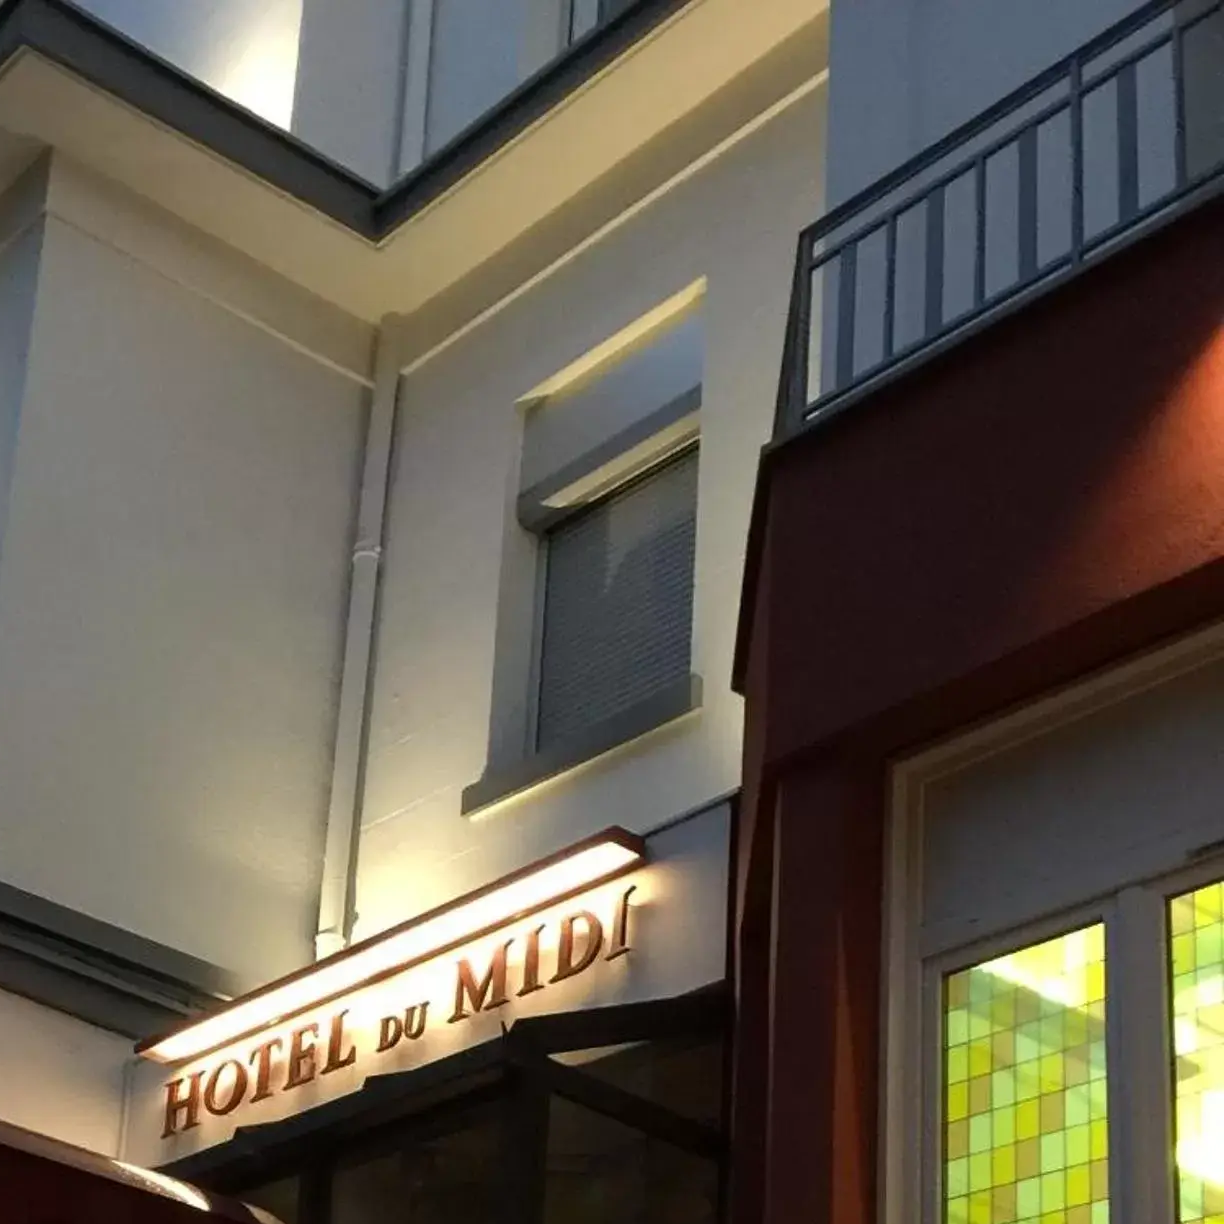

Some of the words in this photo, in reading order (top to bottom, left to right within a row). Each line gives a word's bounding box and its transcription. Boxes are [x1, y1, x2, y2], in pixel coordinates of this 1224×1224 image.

[160, 1008, 358, 1138] HOTEL
[376, 1001, 430, 1051] DU
[446, 884, 637, 1024] MIDI
